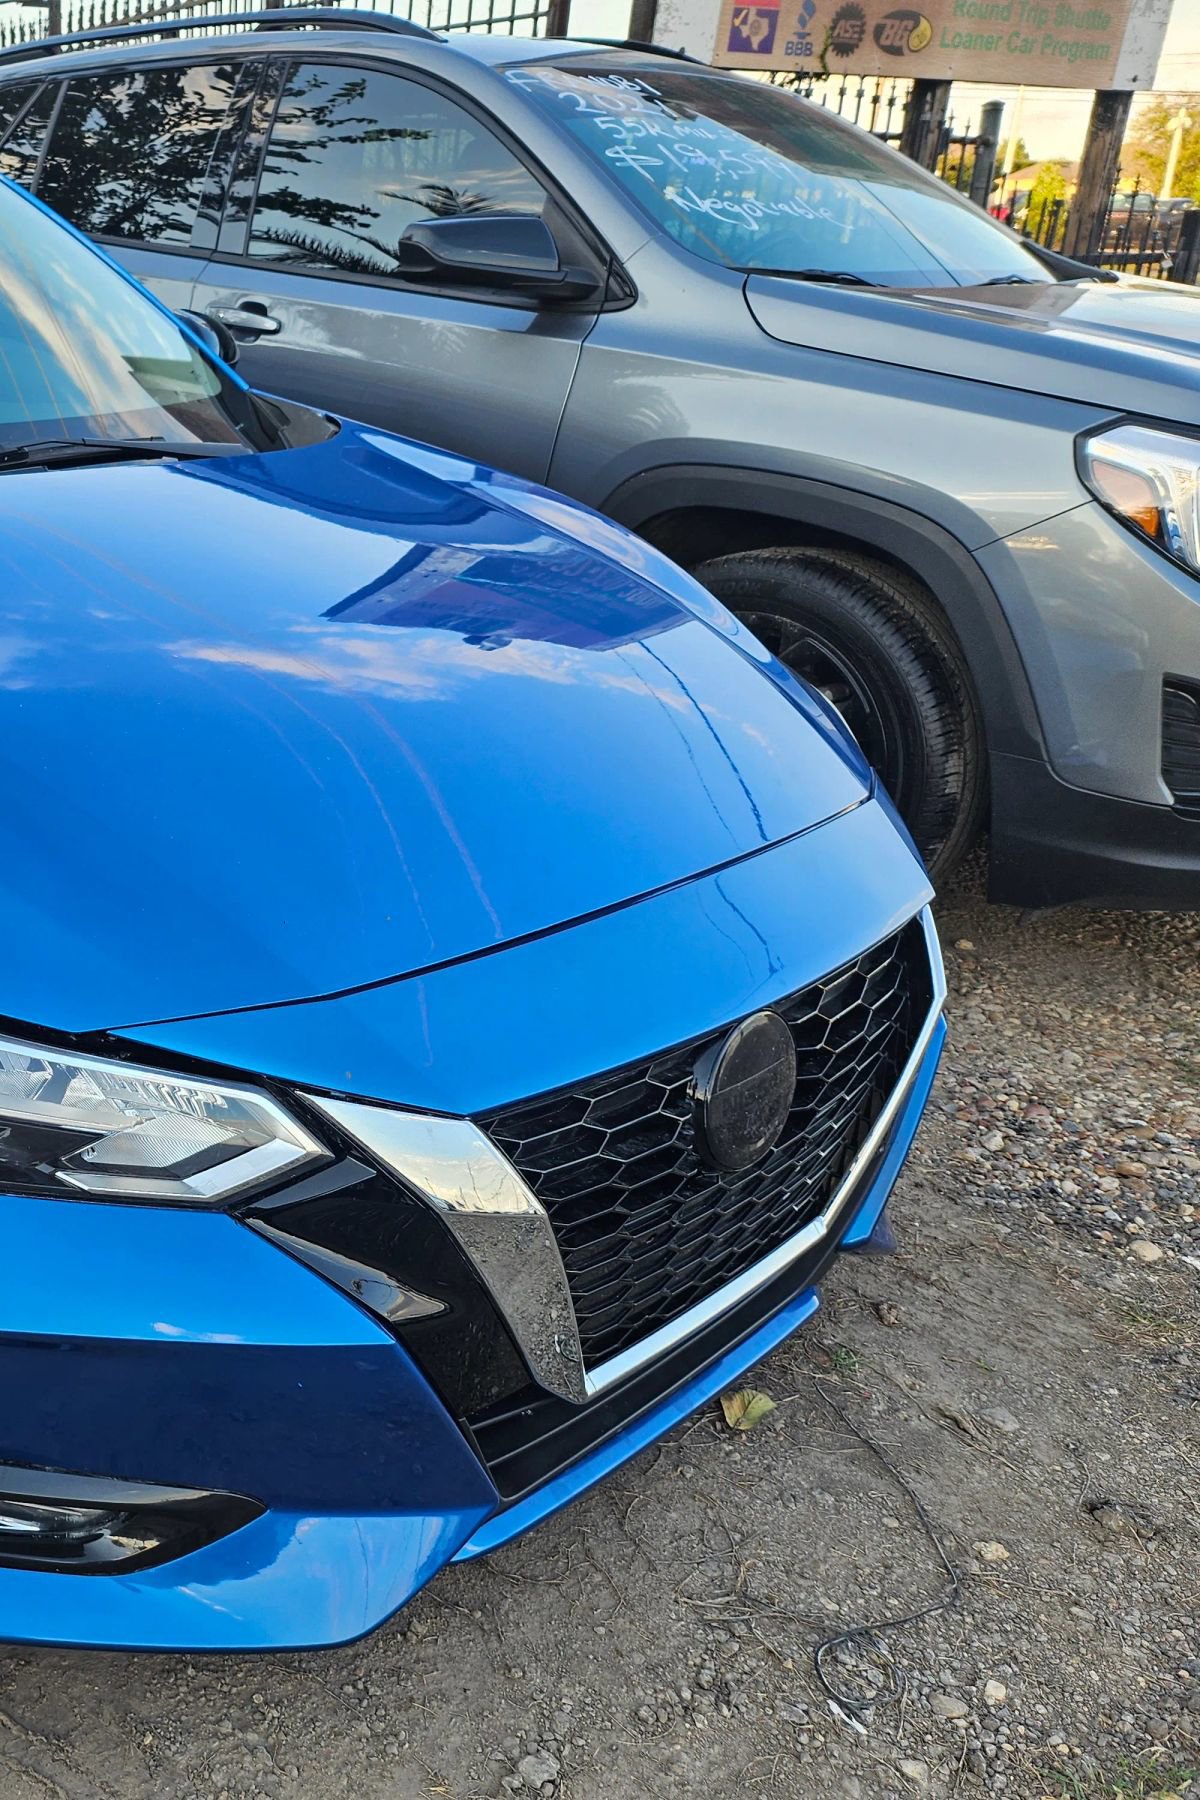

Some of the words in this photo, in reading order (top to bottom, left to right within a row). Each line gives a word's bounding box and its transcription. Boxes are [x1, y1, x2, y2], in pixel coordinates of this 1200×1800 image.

[1018, 0, 1050, 29] Trip
[832, 20, 861, 38] ASE
[784, 41, 814, 57] BBB
[939, 26, 1002, 51] Loaner
[1007, 31, 1037, 54] Car
[1041, 33, 1111, 64] Program
